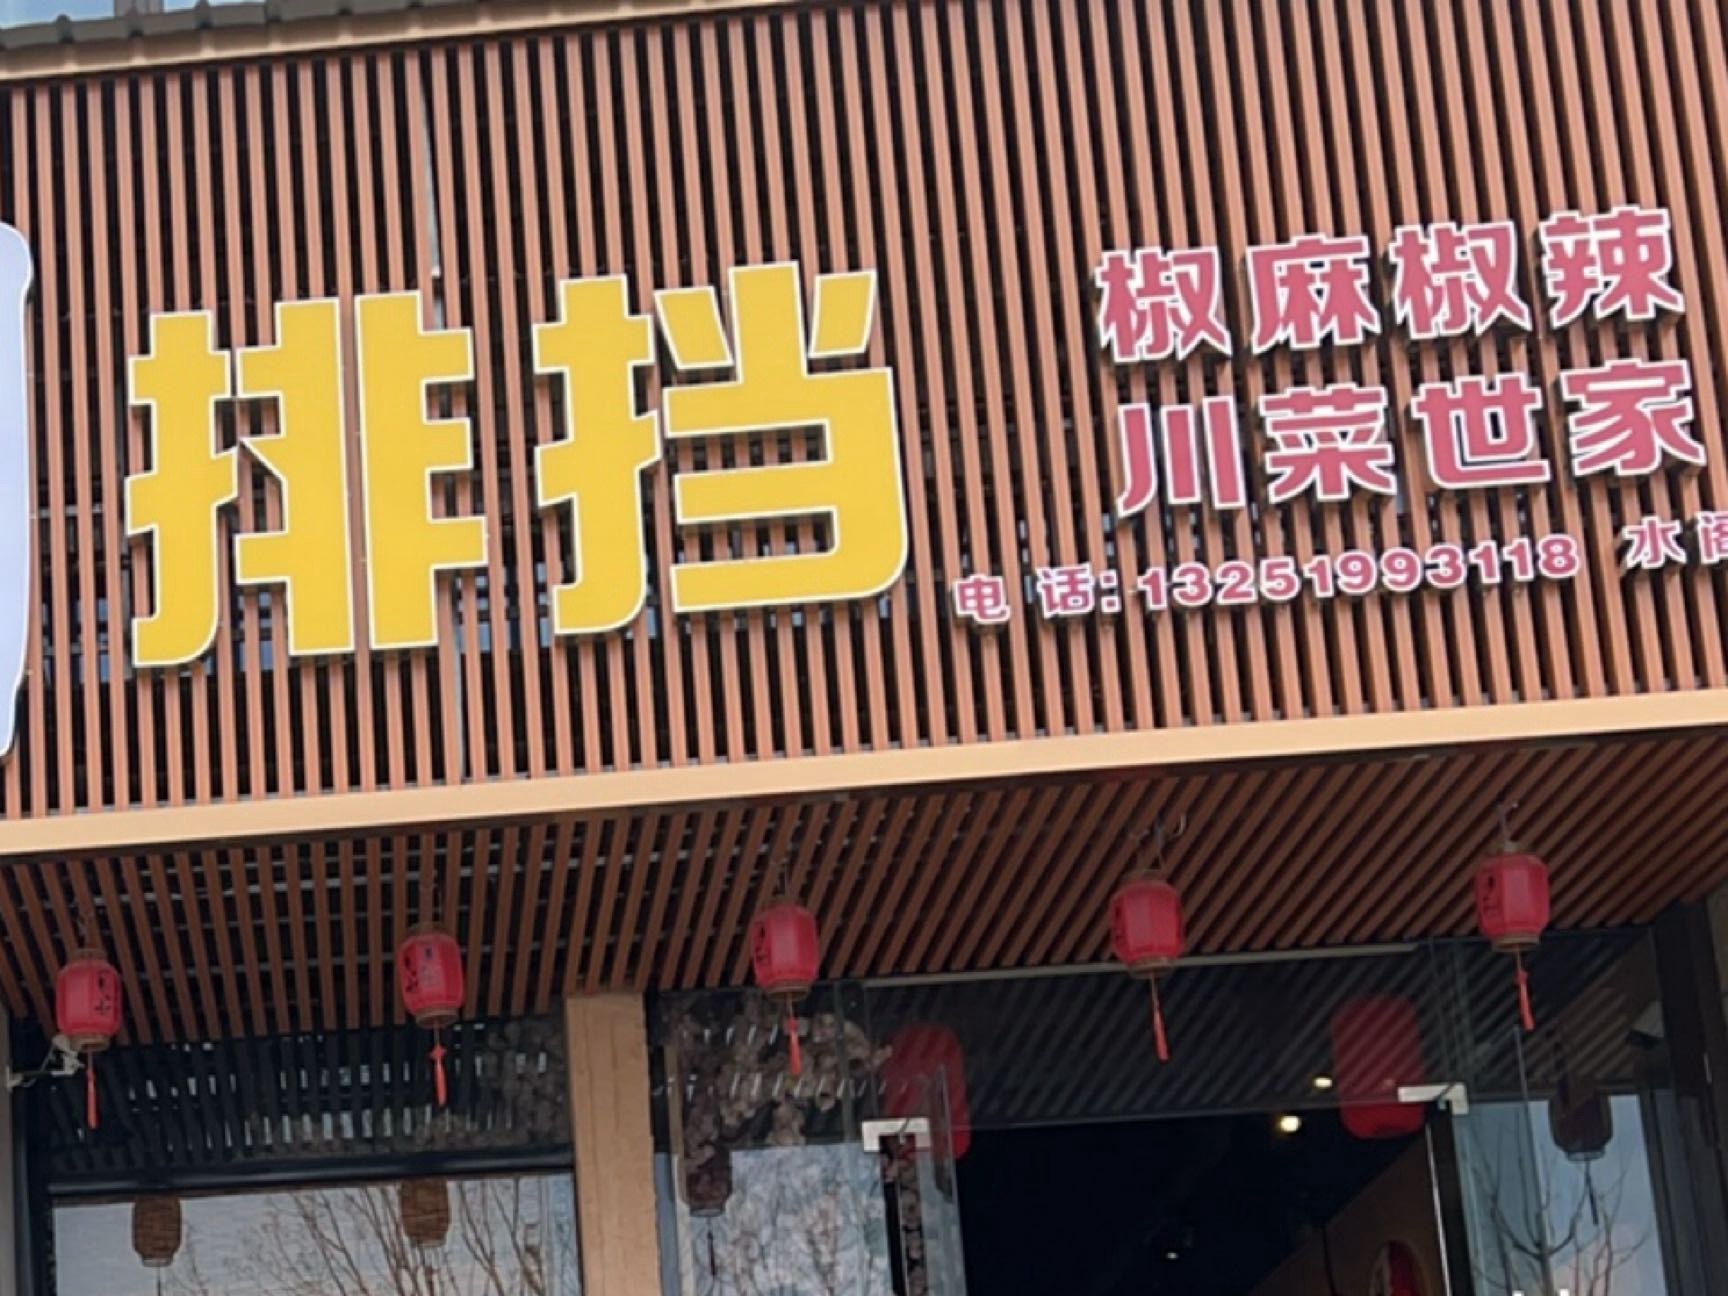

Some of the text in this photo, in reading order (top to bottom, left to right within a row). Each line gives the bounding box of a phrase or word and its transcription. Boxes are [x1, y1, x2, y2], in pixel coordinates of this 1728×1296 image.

[1094, 204, 1686, 364] 椒麻椒辣
[1116, 358, 1708, 518] 川菜世家
